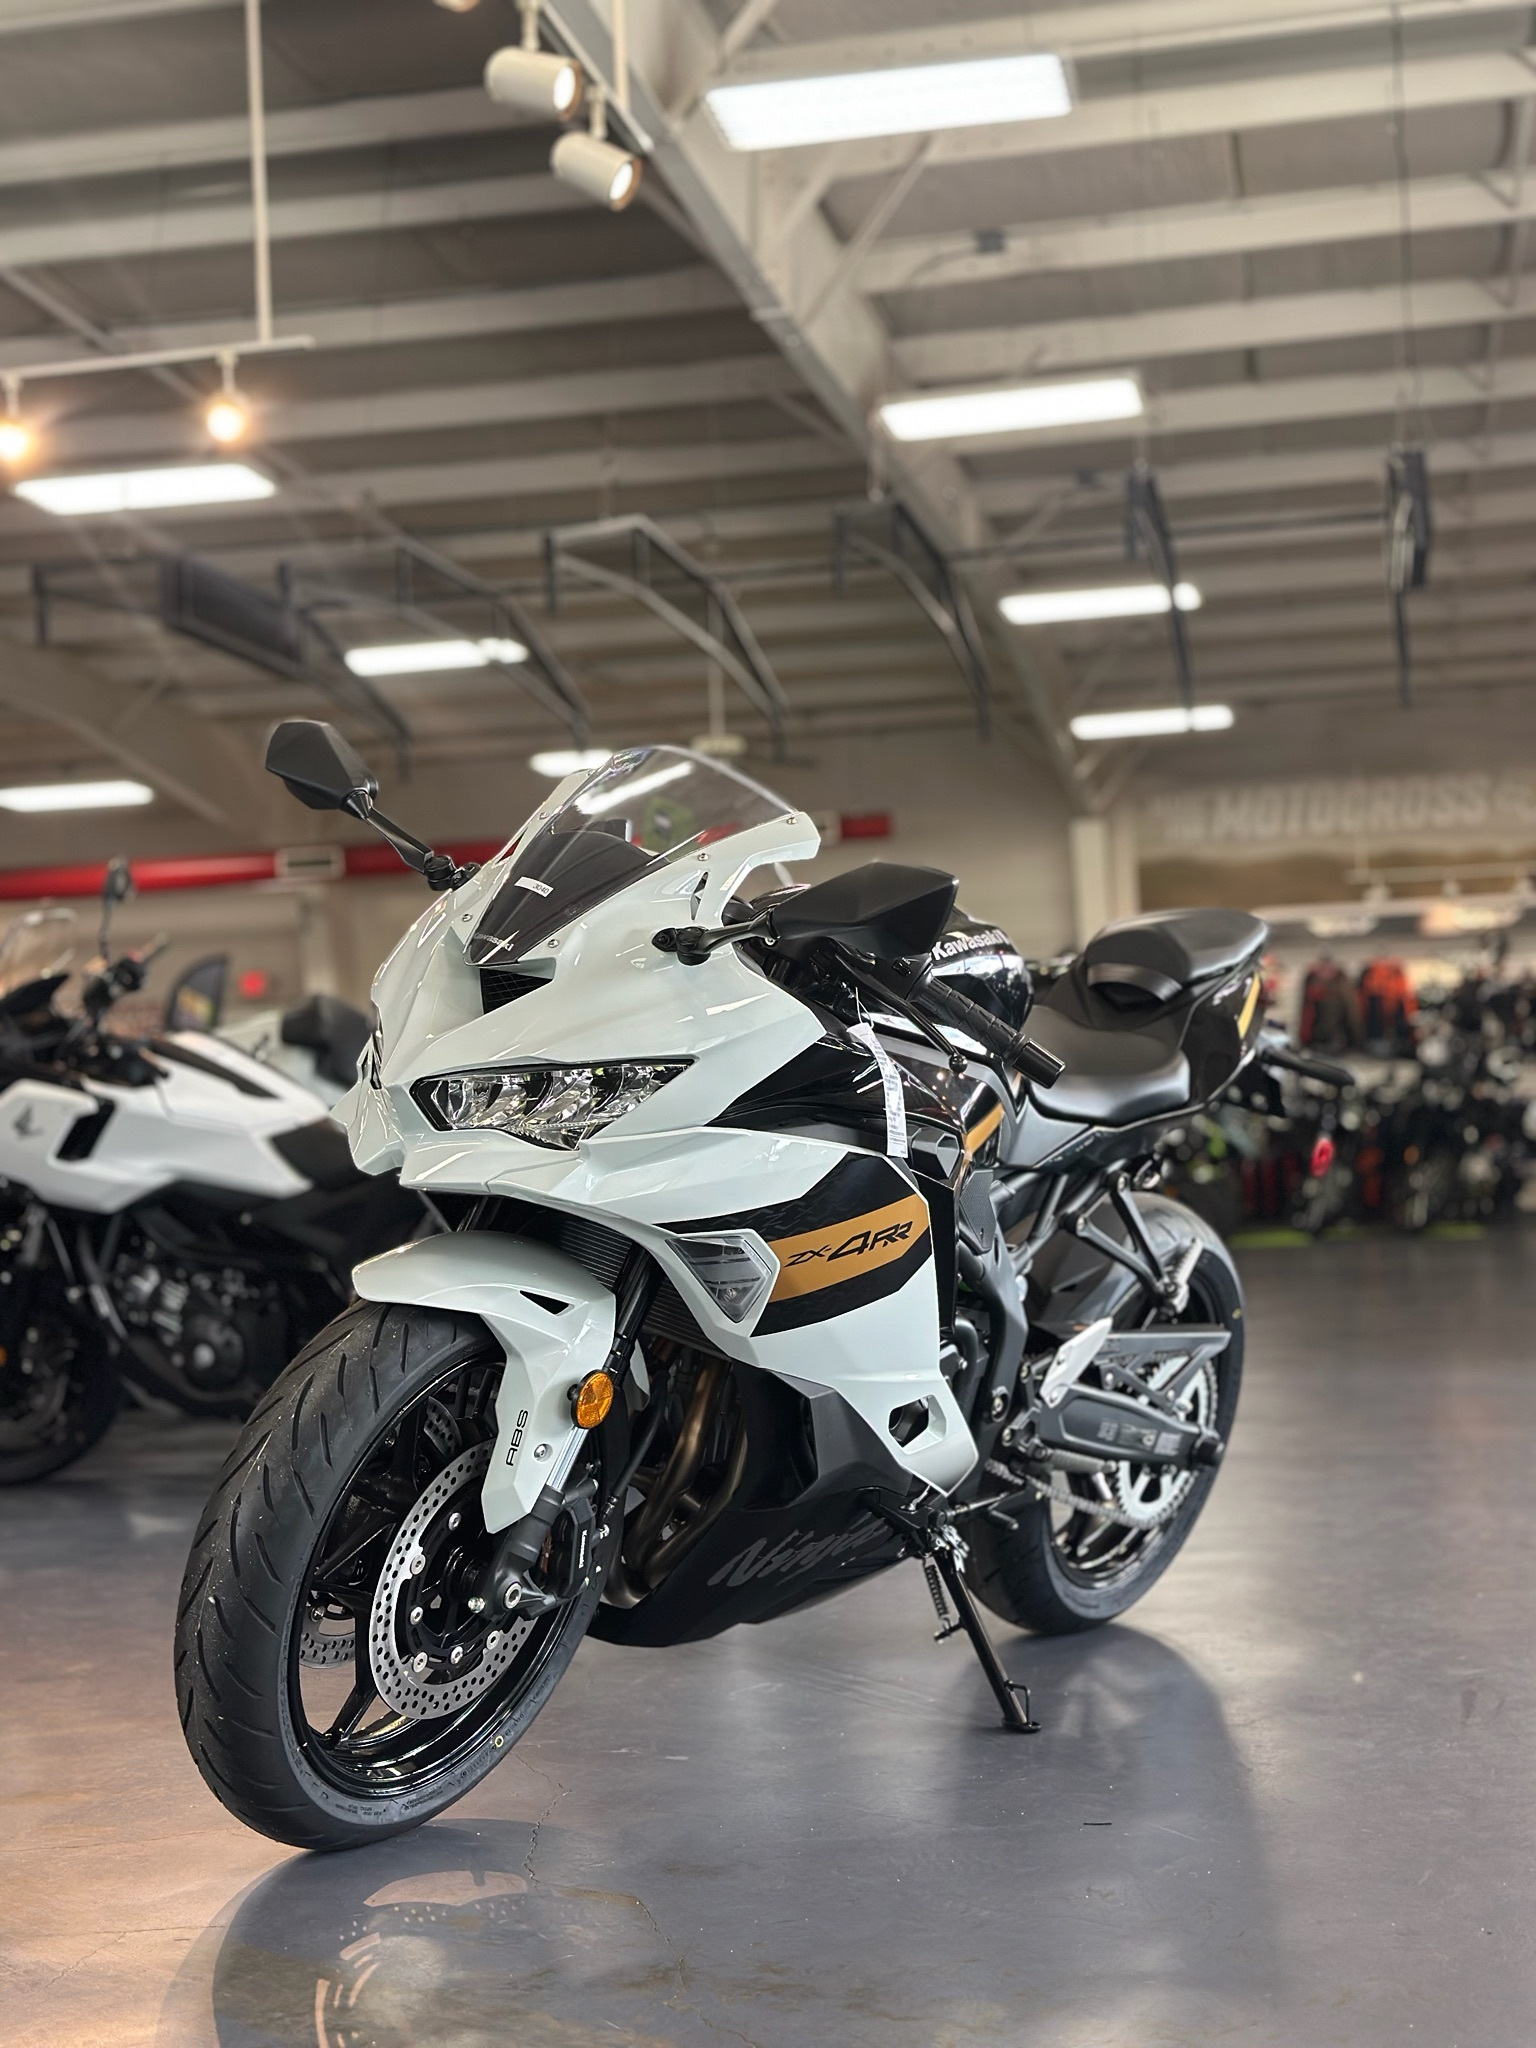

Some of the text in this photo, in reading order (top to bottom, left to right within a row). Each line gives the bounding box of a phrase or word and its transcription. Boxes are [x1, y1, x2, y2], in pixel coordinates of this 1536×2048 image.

[532, 883, 550, 895] 3040
[931, 928, 1007, 961] Kawasaki
[505, 1409, 529, 1467] ABS
[707, 1511, 889, 1587] Ninja
